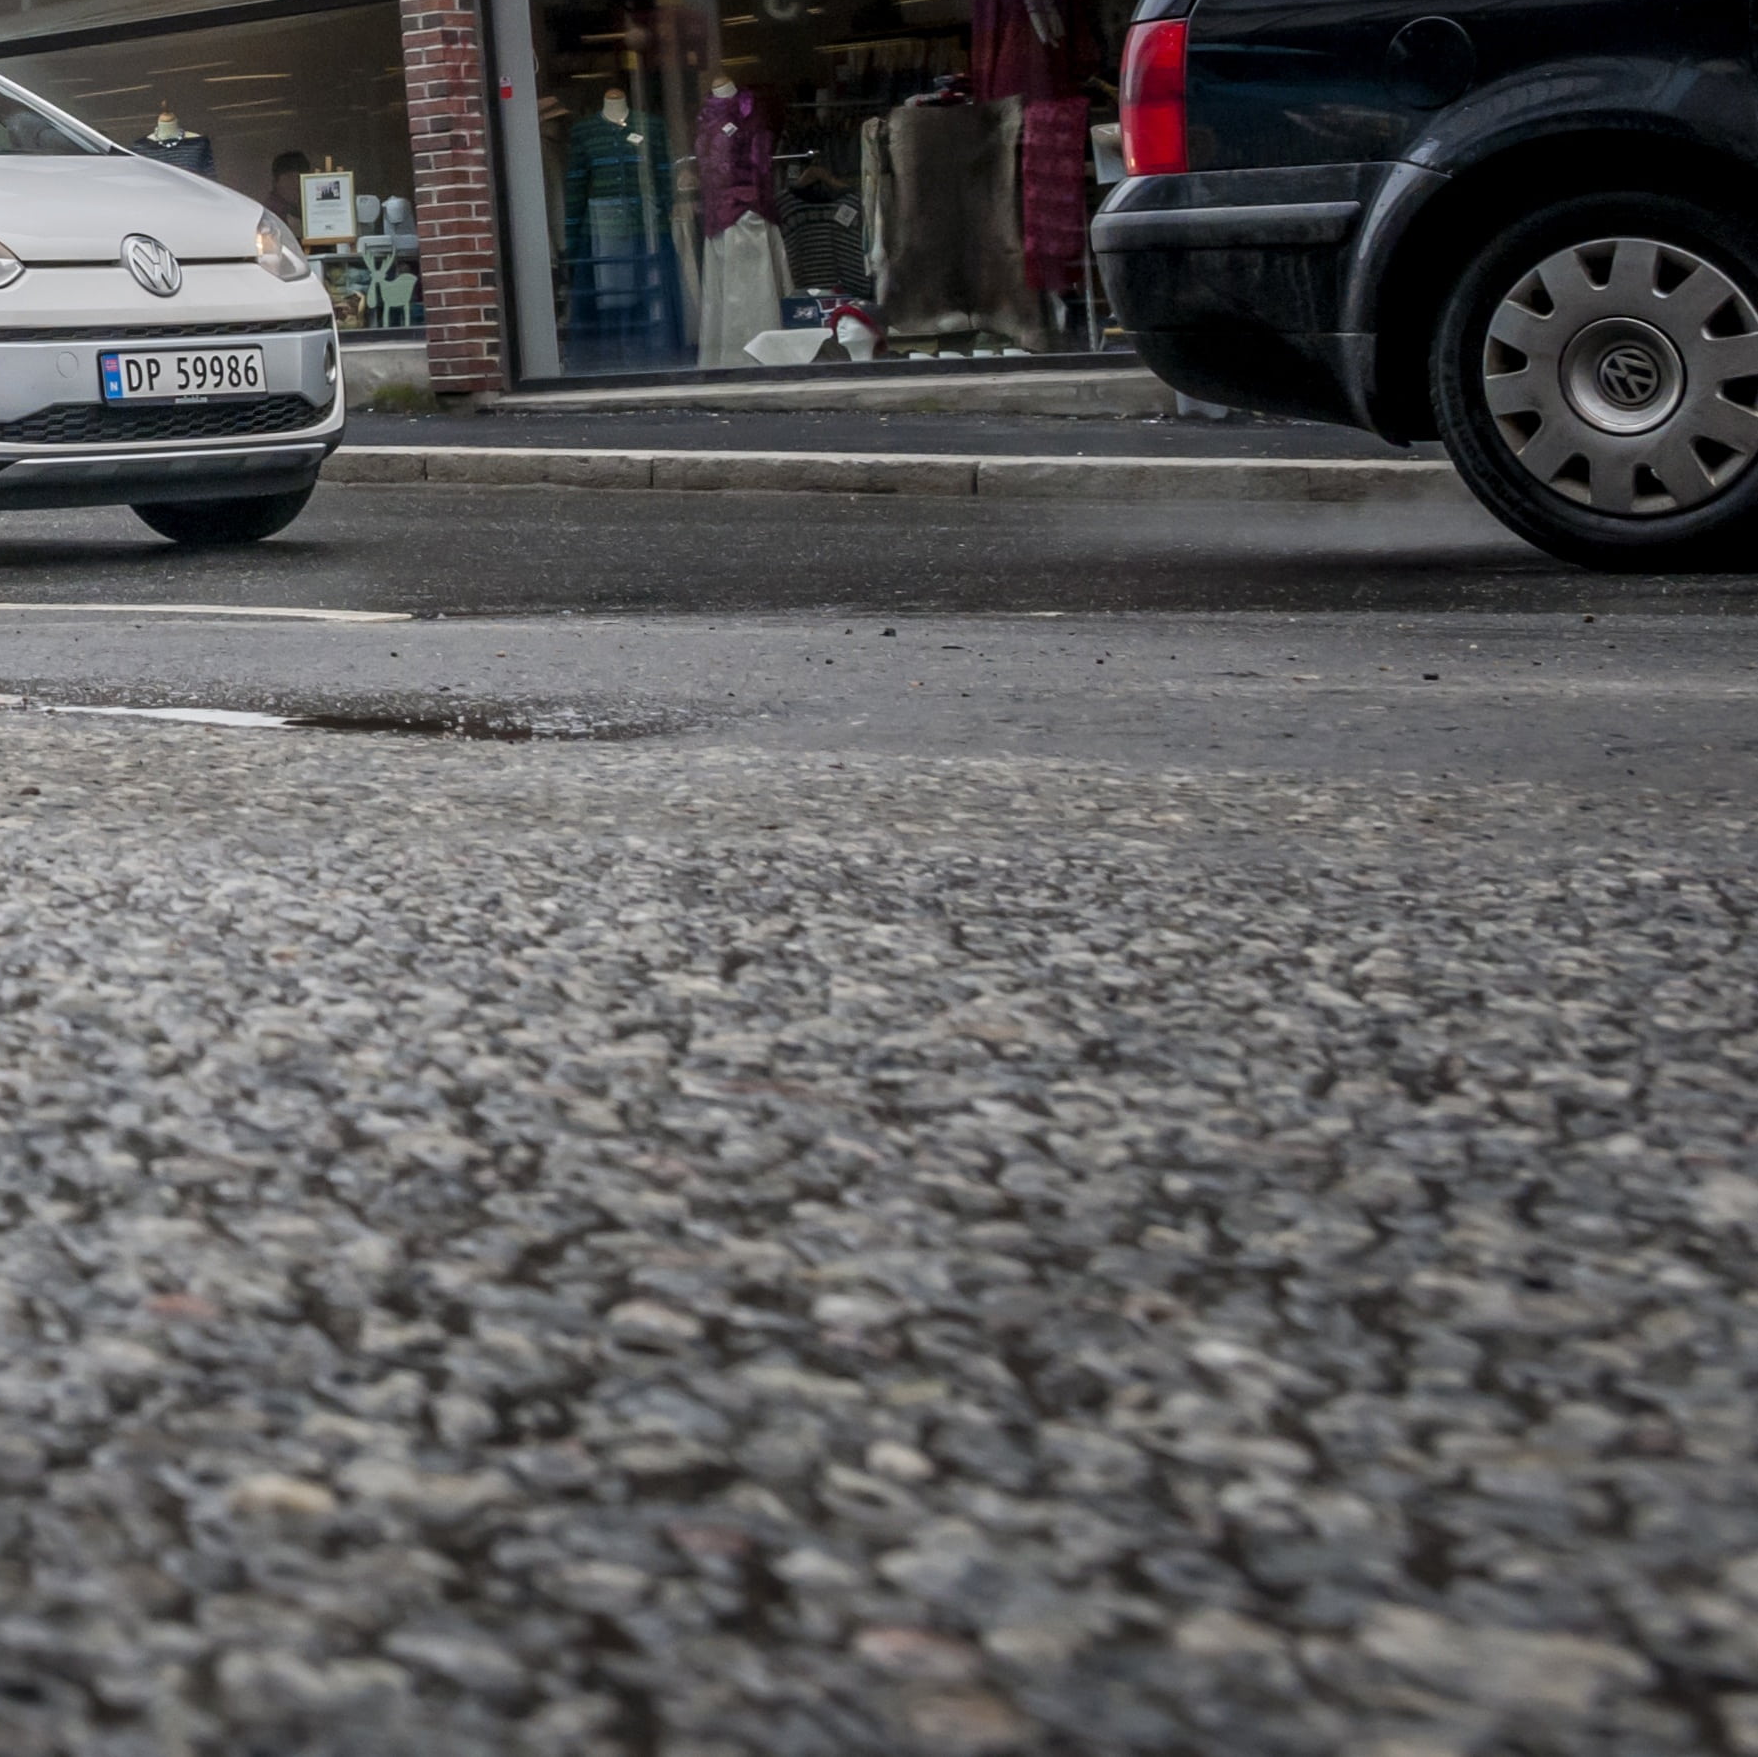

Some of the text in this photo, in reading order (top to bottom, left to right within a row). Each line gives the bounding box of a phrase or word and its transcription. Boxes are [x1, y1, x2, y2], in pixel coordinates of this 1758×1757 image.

[125, 354, 259, 392] DP 59986
[110, 381, 119, 392] N
